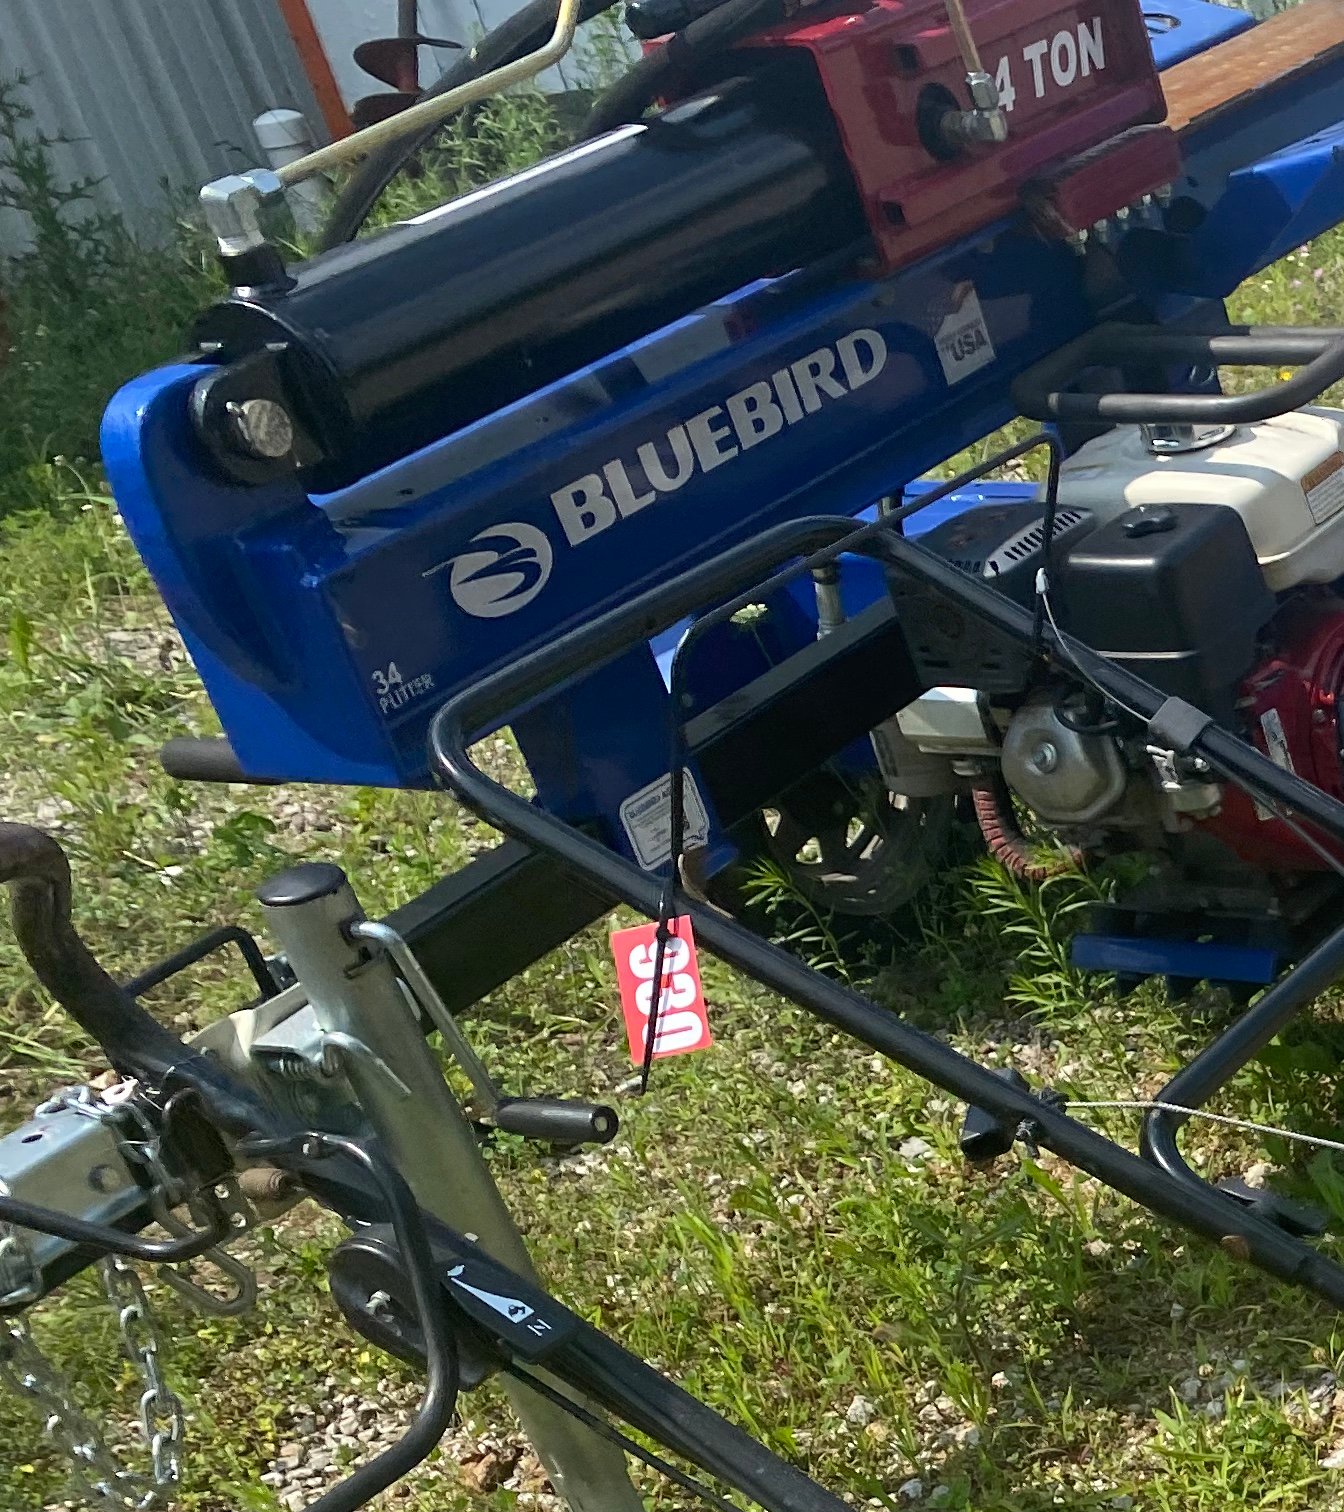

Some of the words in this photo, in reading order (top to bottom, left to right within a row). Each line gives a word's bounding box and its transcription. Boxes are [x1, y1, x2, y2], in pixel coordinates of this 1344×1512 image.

[1023, 17, 1106, 98] TON
[550, 328, 888, 548] BLUEBIRD
[371, 661, 403, 695] 34
[629, 937, 703, 1053] 930
